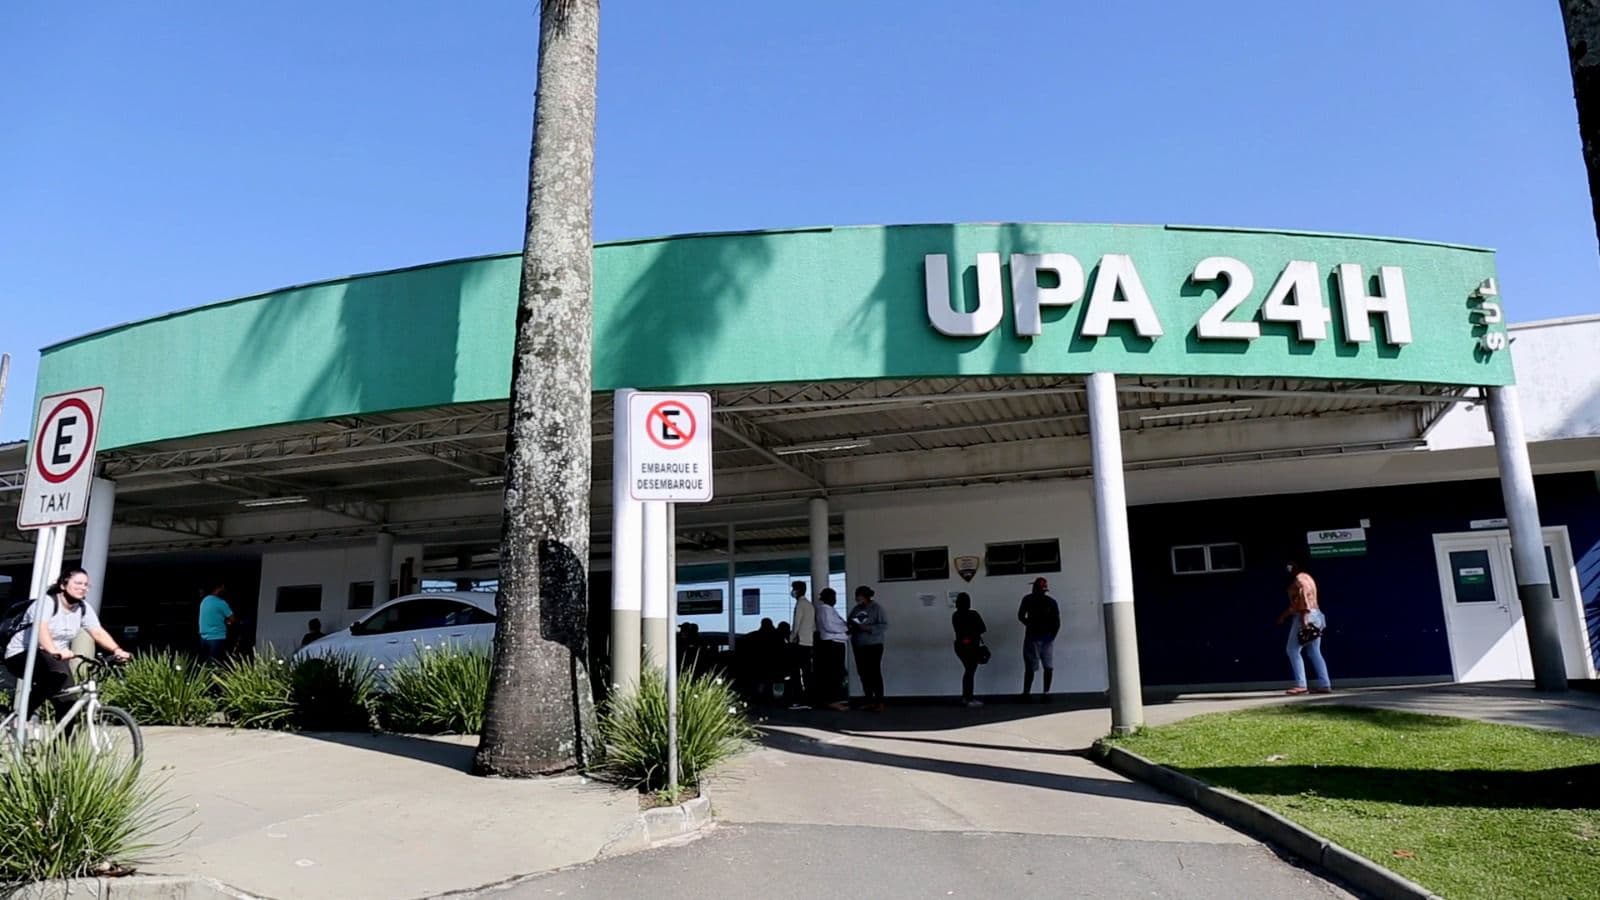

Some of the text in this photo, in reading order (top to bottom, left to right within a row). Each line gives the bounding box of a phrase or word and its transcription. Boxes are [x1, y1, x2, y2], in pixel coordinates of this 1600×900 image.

[925, 252, 1413, 345] UPA 24H
[1478, 277, 1506, 351] SUL
[662, 410, 680, 440] E
[51, 416, 77, 465] E
[641, 463, 699, 473] EMBARQUE E
[637, 479, 703, 490] DESEMBARQUE
[40, 492, 70, 513] TAXI
